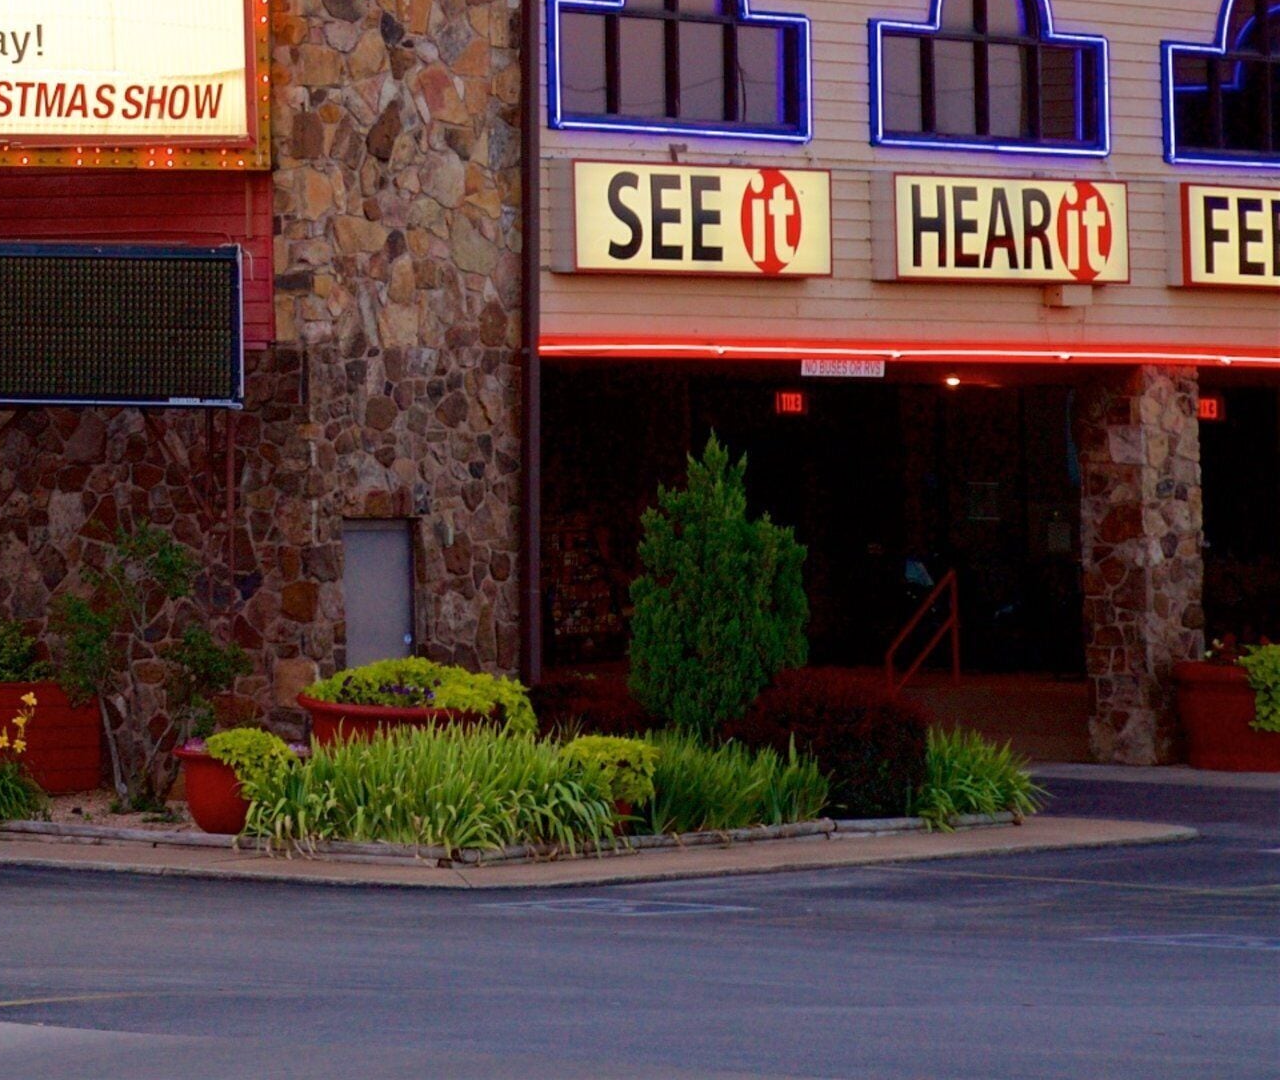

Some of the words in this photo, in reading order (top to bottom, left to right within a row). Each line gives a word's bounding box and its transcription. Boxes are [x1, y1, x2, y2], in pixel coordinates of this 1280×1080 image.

[607, 170, 724, 262] SEE
[748, 170, 796, 265] it
[911, 184, 1054, 270] HEAR
[1063, 183, 1108, 273] it
